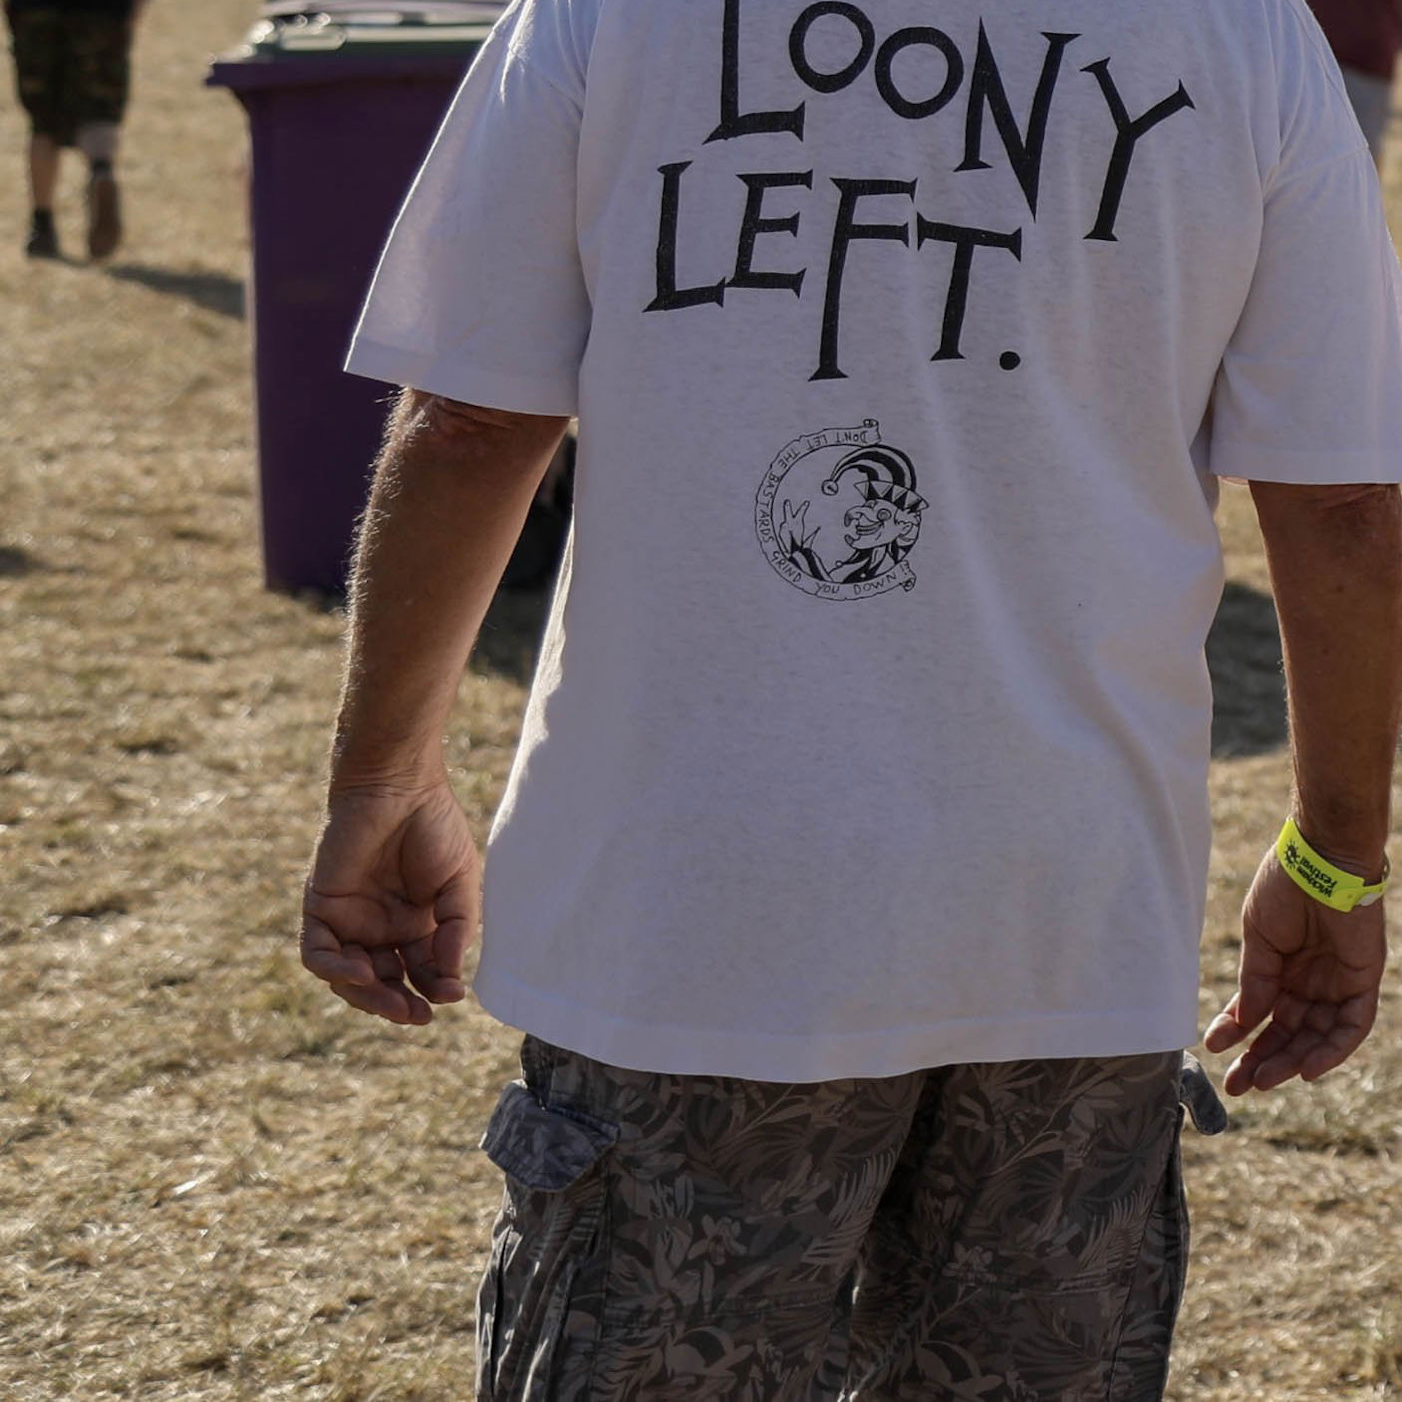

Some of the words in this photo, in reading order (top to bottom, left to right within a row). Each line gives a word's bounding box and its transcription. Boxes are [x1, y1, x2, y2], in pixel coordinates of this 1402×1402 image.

[642, 159, 1022, 382] LEFT.
[806, 434, 828, 450] LET
[836, 430, 868, 444] DON'T
[778, 448, 801, 469] THE
[758, 472, 780, 543] BASTARDS
[771, 550, 802, 583] GRIND
[815, 582, 840, 596] YOU
[1296, 865, 1332, 898] Wickham
[1299, 856, 1338, 888] Festival
